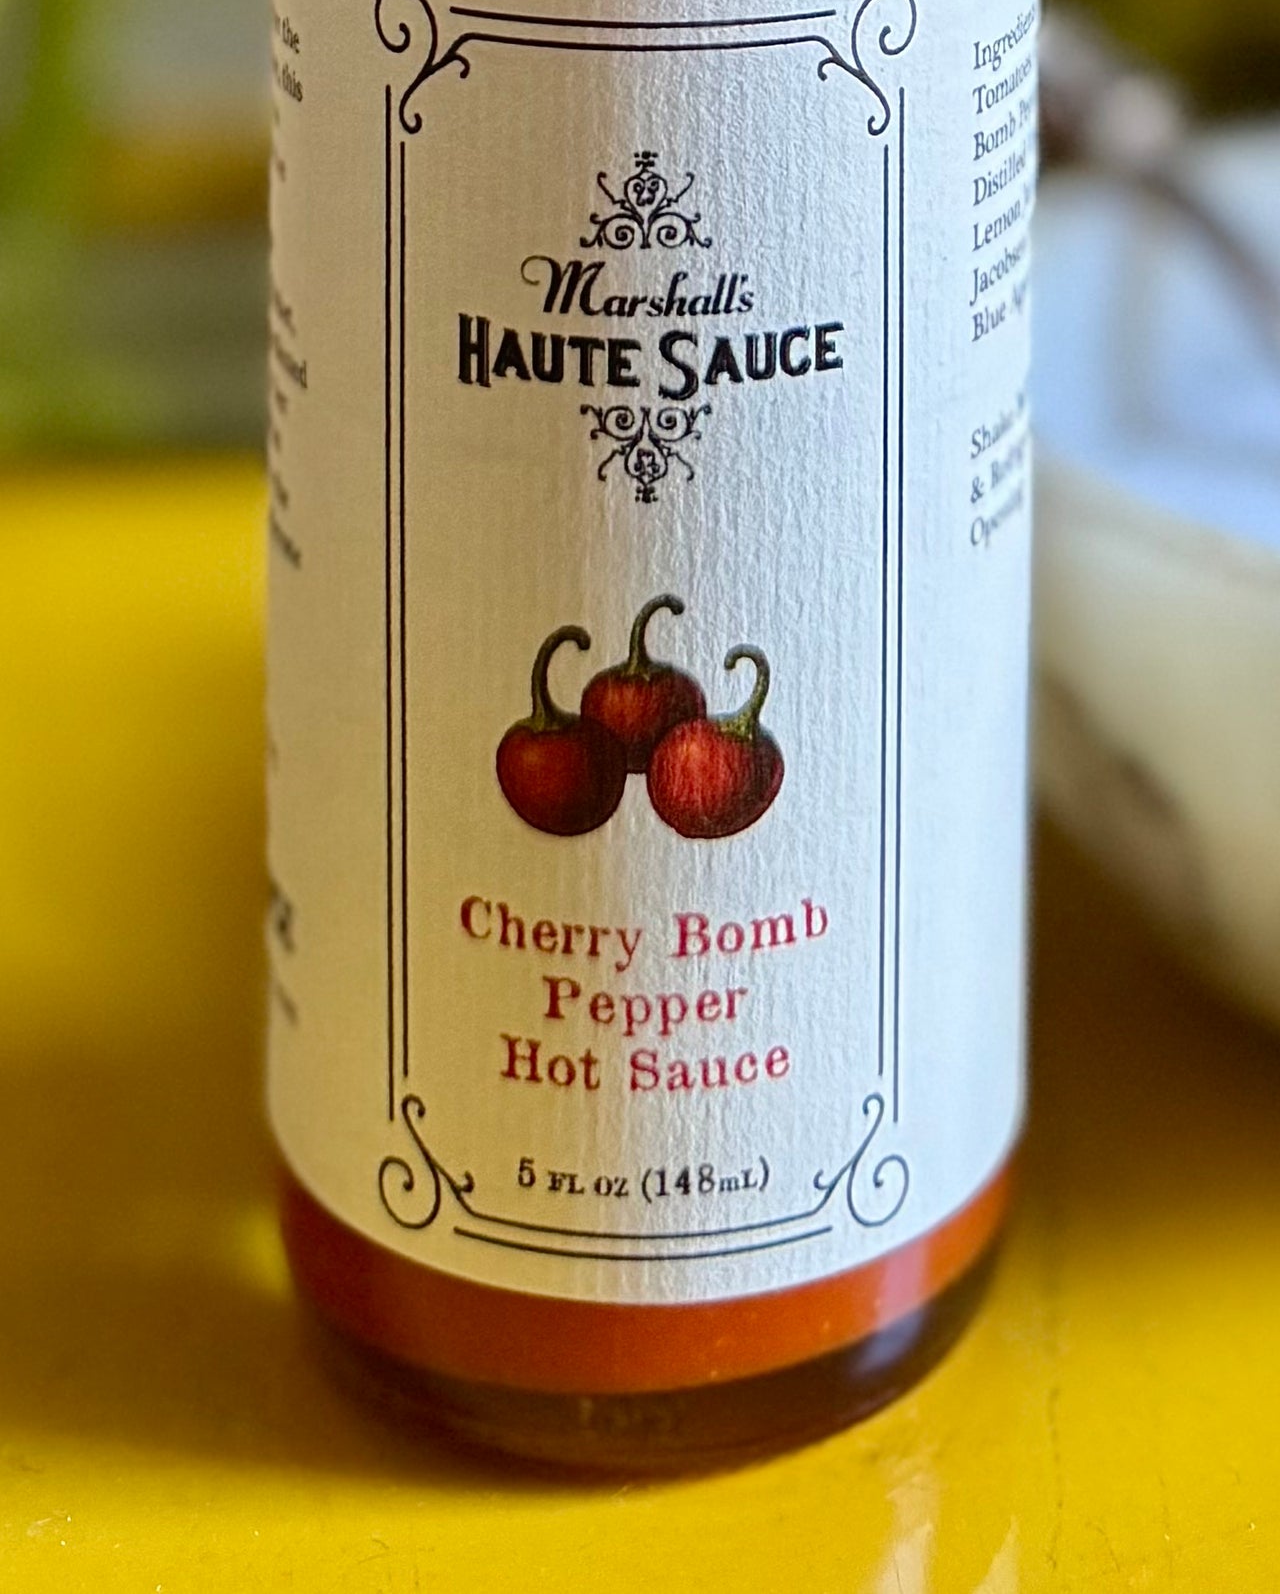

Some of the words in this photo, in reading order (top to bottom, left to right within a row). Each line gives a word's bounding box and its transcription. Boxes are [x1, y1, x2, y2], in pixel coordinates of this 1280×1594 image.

[972, 111, 1016, 162] Bomb
[972, 140, 1027, 207] Distilled
[972, 199, 1021, 252] Lemon
[520, 255, 755, 319] Marshall's
[971, 300, 1007, 342] Blue
[457, 312, 642, 389] HAUTE
[657, 320, 845, 403] SAUCE
[970, 476, 985, 504] &
[459, 895, 643, 973] Cherry
[669, 897, 829, 962] Bomb
[542, 975, 749, 1040] Pepper
[500, 1033, 601, 1092] Hot
[629, 1045, 790, 1095] Sauce
[517, 1156, 537, 1190] 5
[547, 1170, 586, 1196] FL
[640, 1155, 771, 1205] (148mL)
